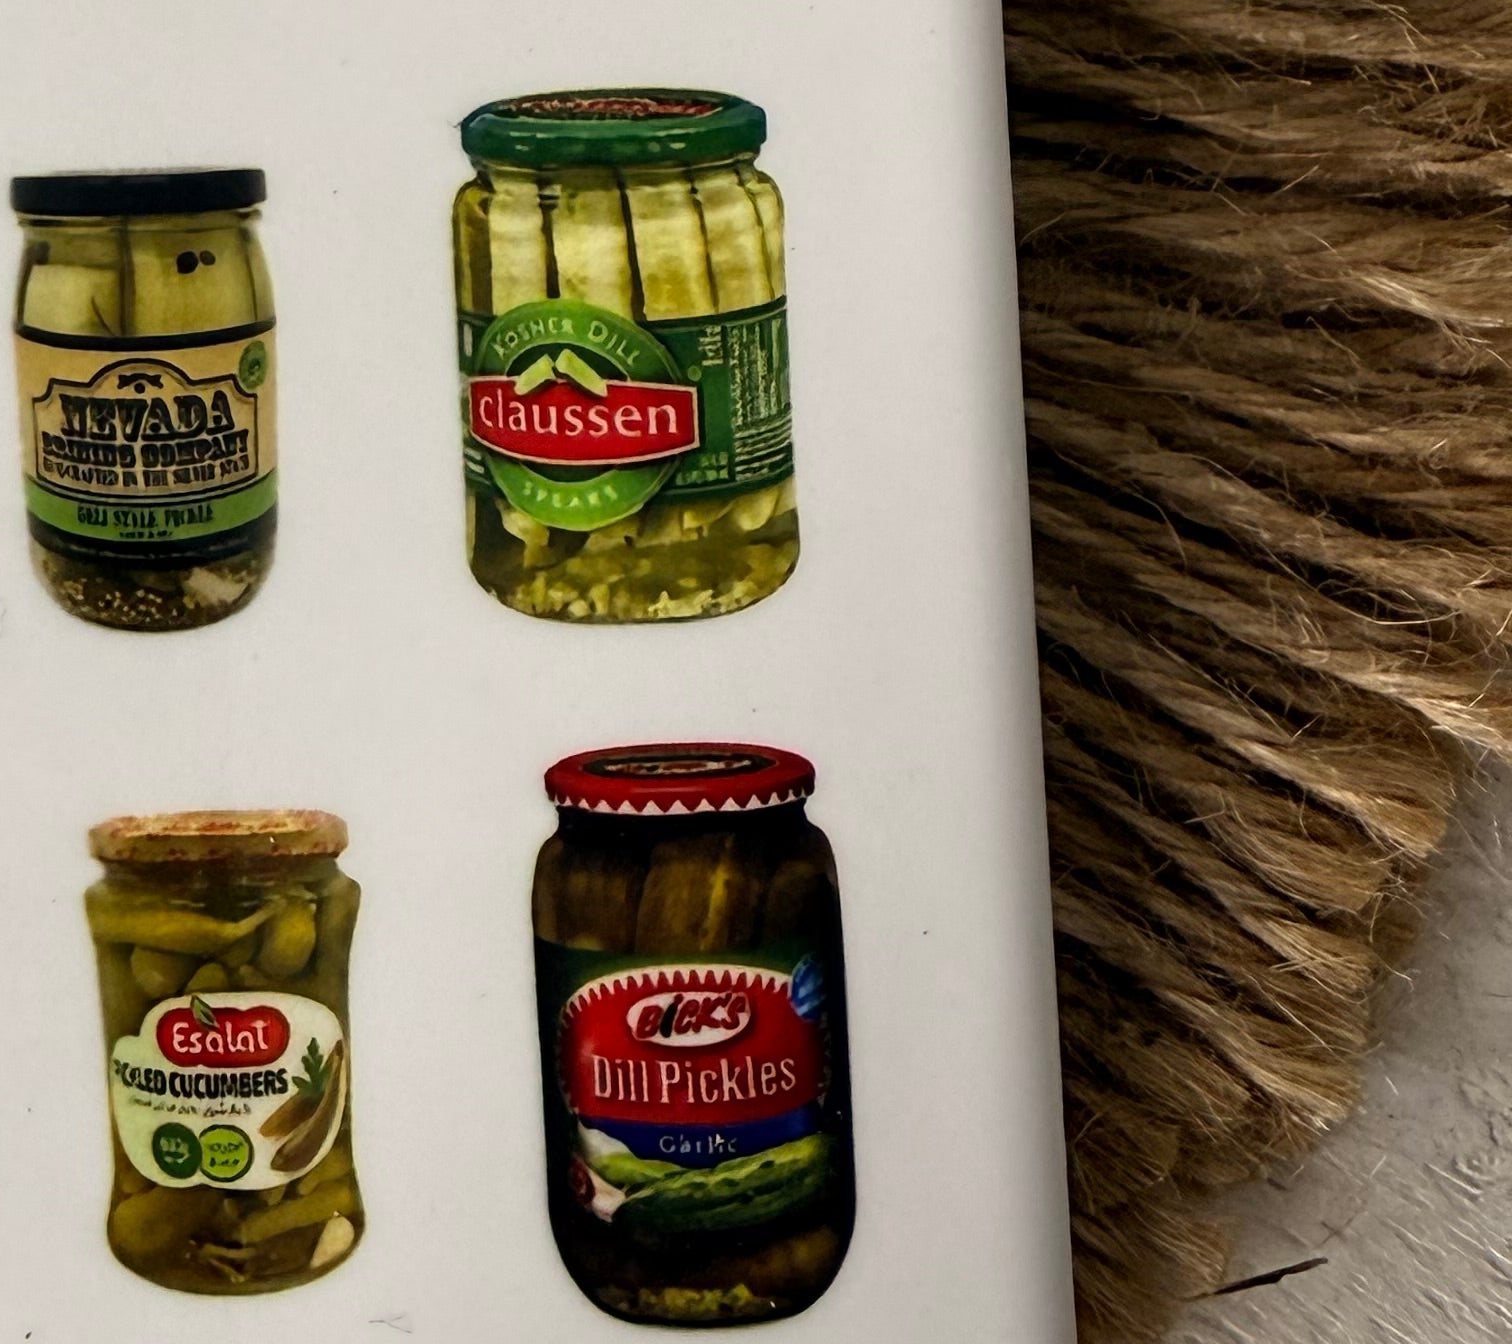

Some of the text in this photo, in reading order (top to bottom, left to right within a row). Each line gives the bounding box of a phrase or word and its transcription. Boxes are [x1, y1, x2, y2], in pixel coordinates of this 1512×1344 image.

[479, 390, 678, 437] claussen
[169, 1067, 288, 1100] CUCUMBERS
[592, 1054, 796, 1104] Dill Pickles
